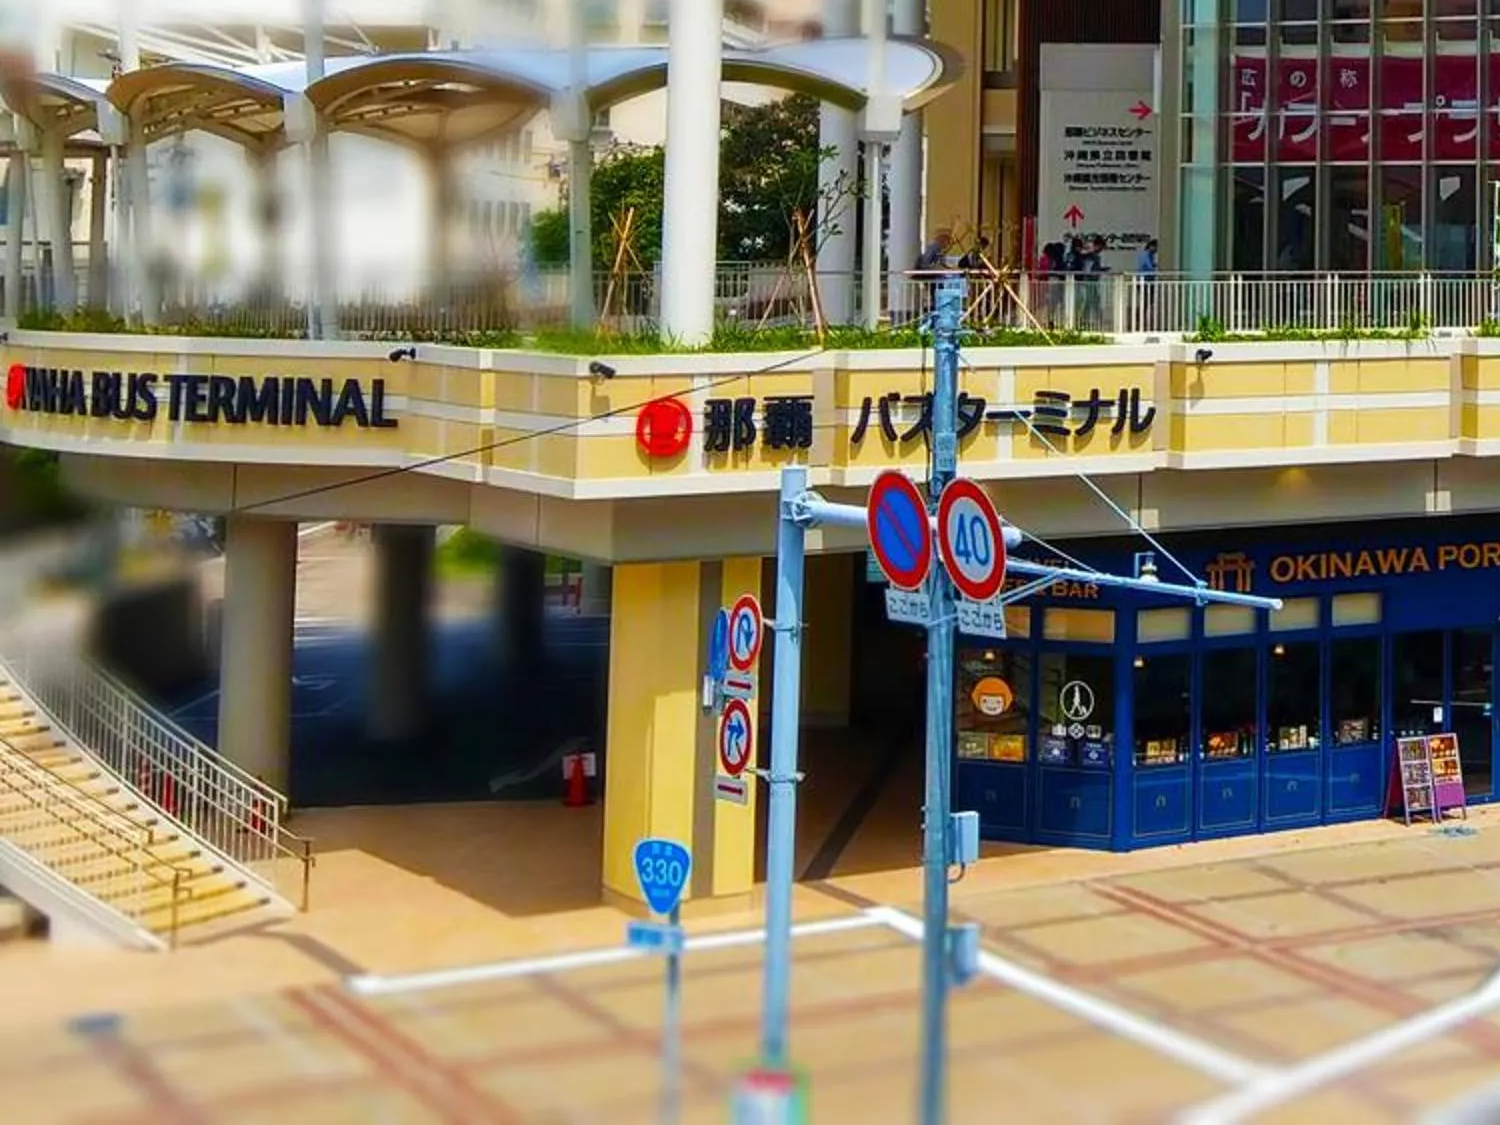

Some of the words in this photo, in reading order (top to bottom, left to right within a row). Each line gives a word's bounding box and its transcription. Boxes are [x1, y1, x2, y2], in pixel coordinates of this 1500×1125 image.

[21, 366, 87, 416] NAHA
[91, 371, 158, 421] BUS
[164, 373, 398, 428] TERMINAL
[955, 513, 990, 567] 40
[1270, 546, 1431, 583] OKINAWA
[1052, 581, 1099, 599] BAR
[641, 856, 683, 887] 330
